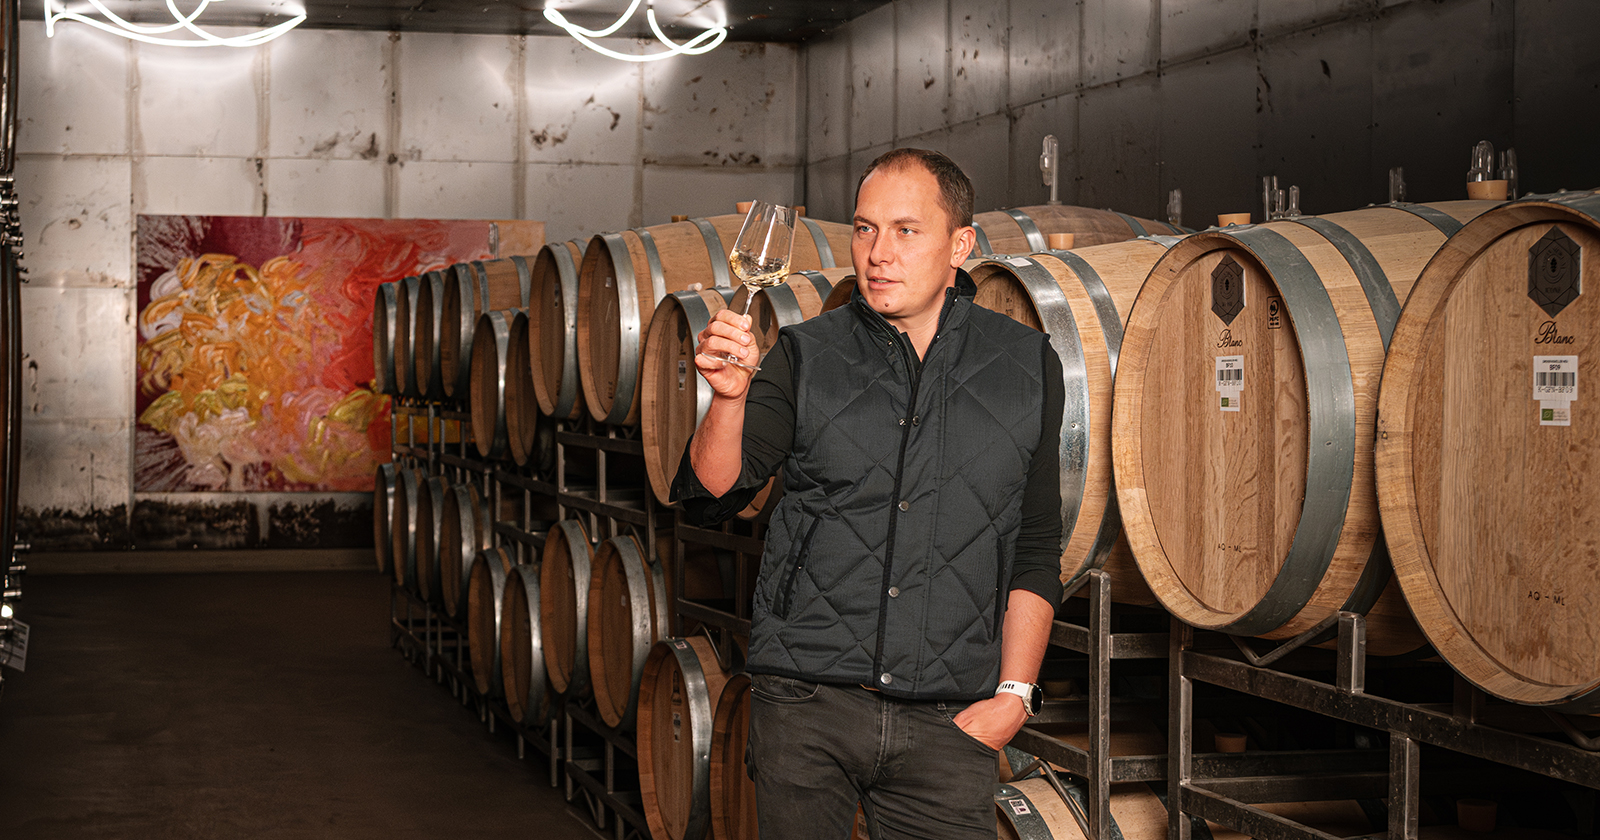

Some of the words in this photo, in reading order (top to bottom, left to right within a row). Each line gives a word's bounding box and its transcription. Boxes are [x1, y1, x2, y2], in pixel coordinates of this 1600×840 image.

[1217, 328, 1243, 348] Blanc
[1534, 320, 1576, 344] Blanc
[1527, 590, 1541, 601] AQ
[1552, 595, 1566, 606] ML
